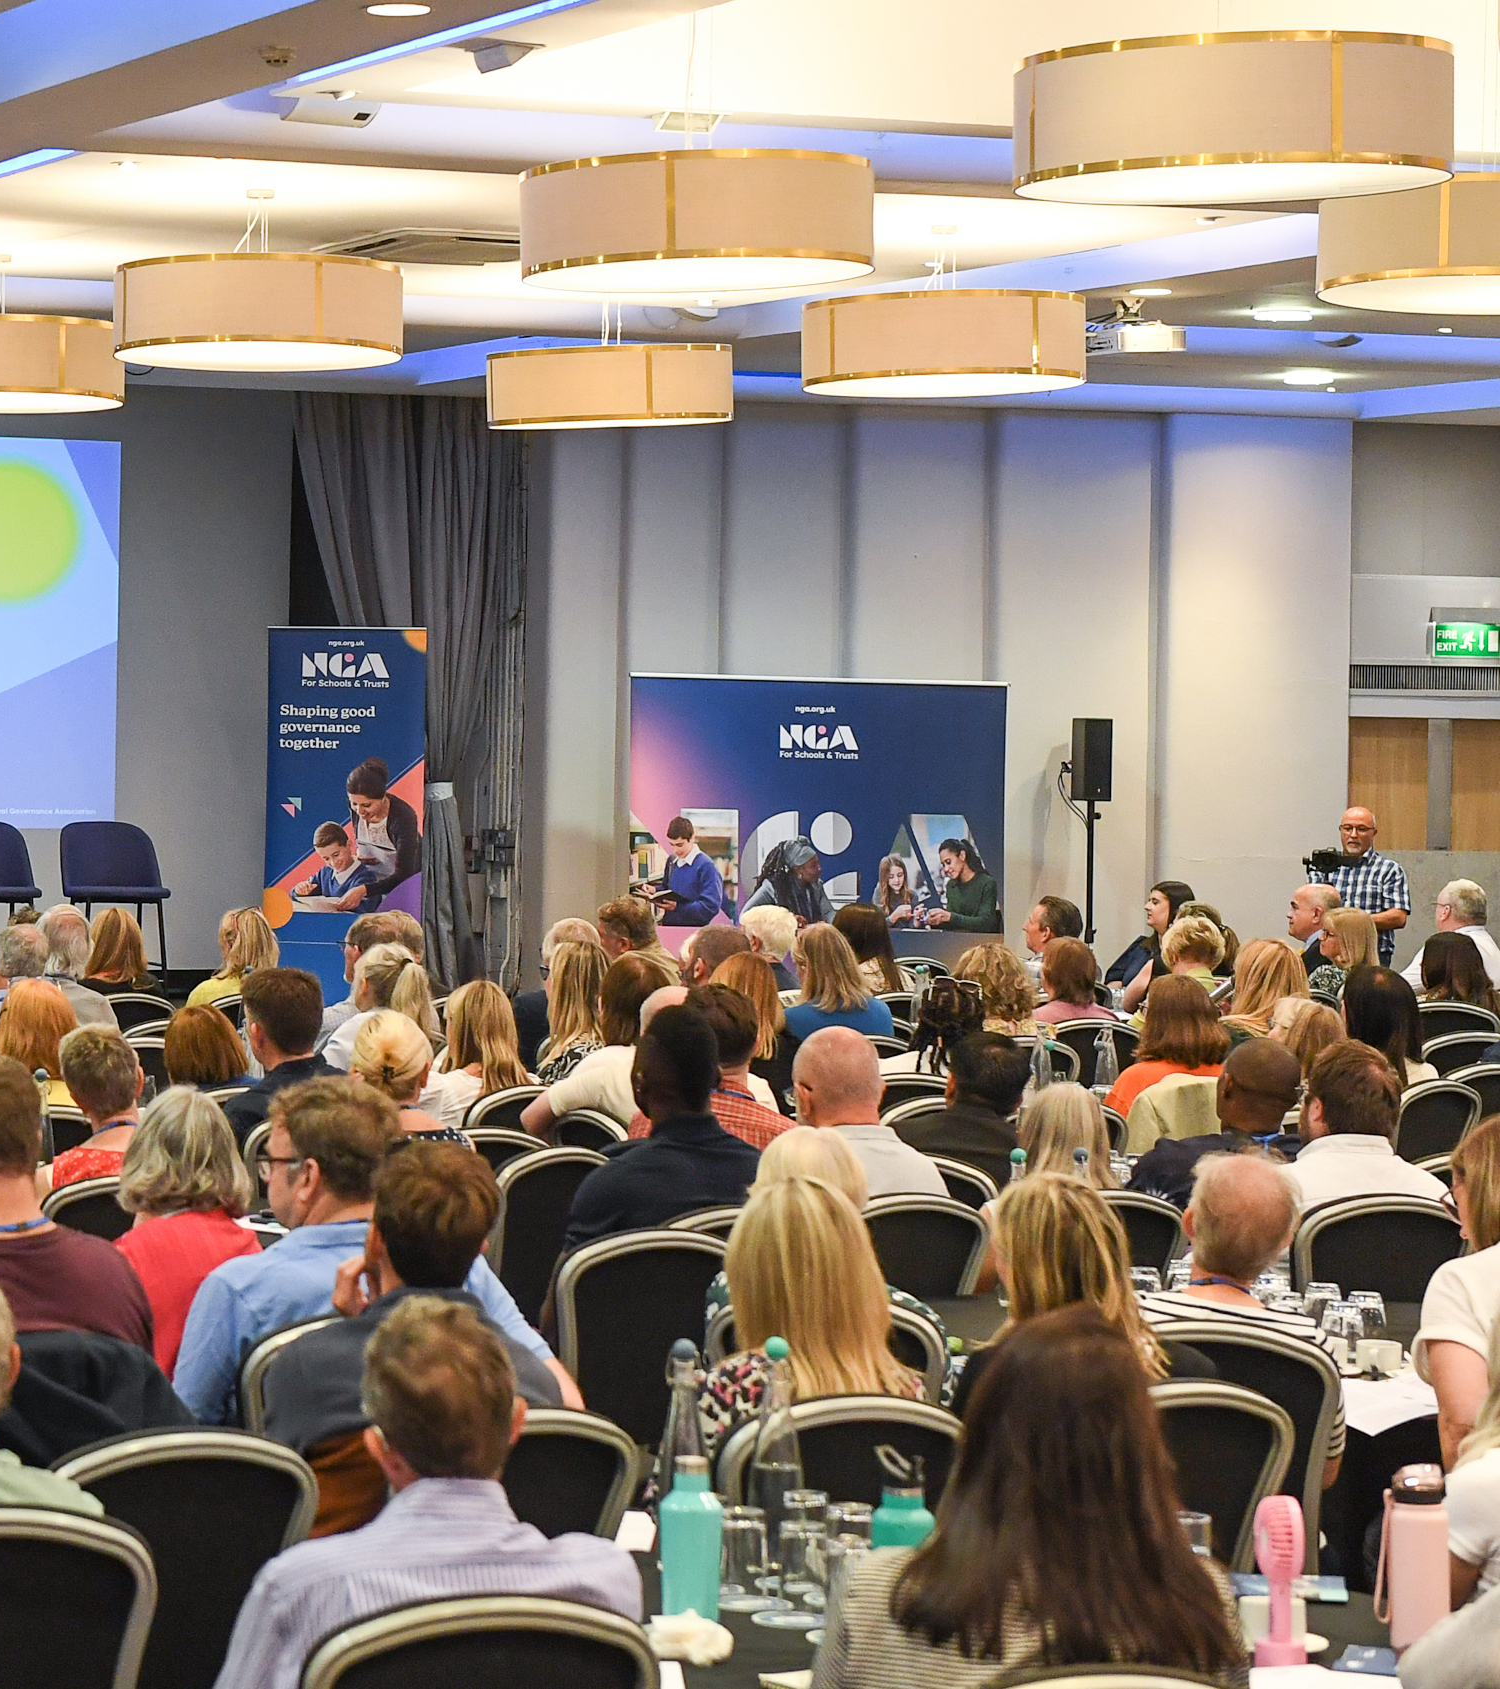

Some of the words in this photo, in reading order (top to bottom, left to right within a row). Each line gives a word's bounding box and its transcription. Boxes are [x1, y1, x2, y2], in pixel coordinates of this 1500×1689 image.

[1437, 630, 1457, 639] FIRE
[1436, 642, 1457, 651] EXIT
[302, 652, 390, 678] NGA
[301, 679, 317, 687] For
[318, 679, 352, 687] Schools
[354, 680, 361, 688] &
[363, 680, 390, 688] Trusts
[279, 704, 338, 719] Shaping
[340, 706, 376, 719] good
[795, 706, 836, 714] nga.org.uk
[279, 722, 361, 735] governance
[779, 724, 859, 750] NGA
[279, 737, 340, 751] together
[794, 751, 825, 759] Schools
[834, 751, 859, 760] Trusts
[9, 807, 53, 815] Governance
